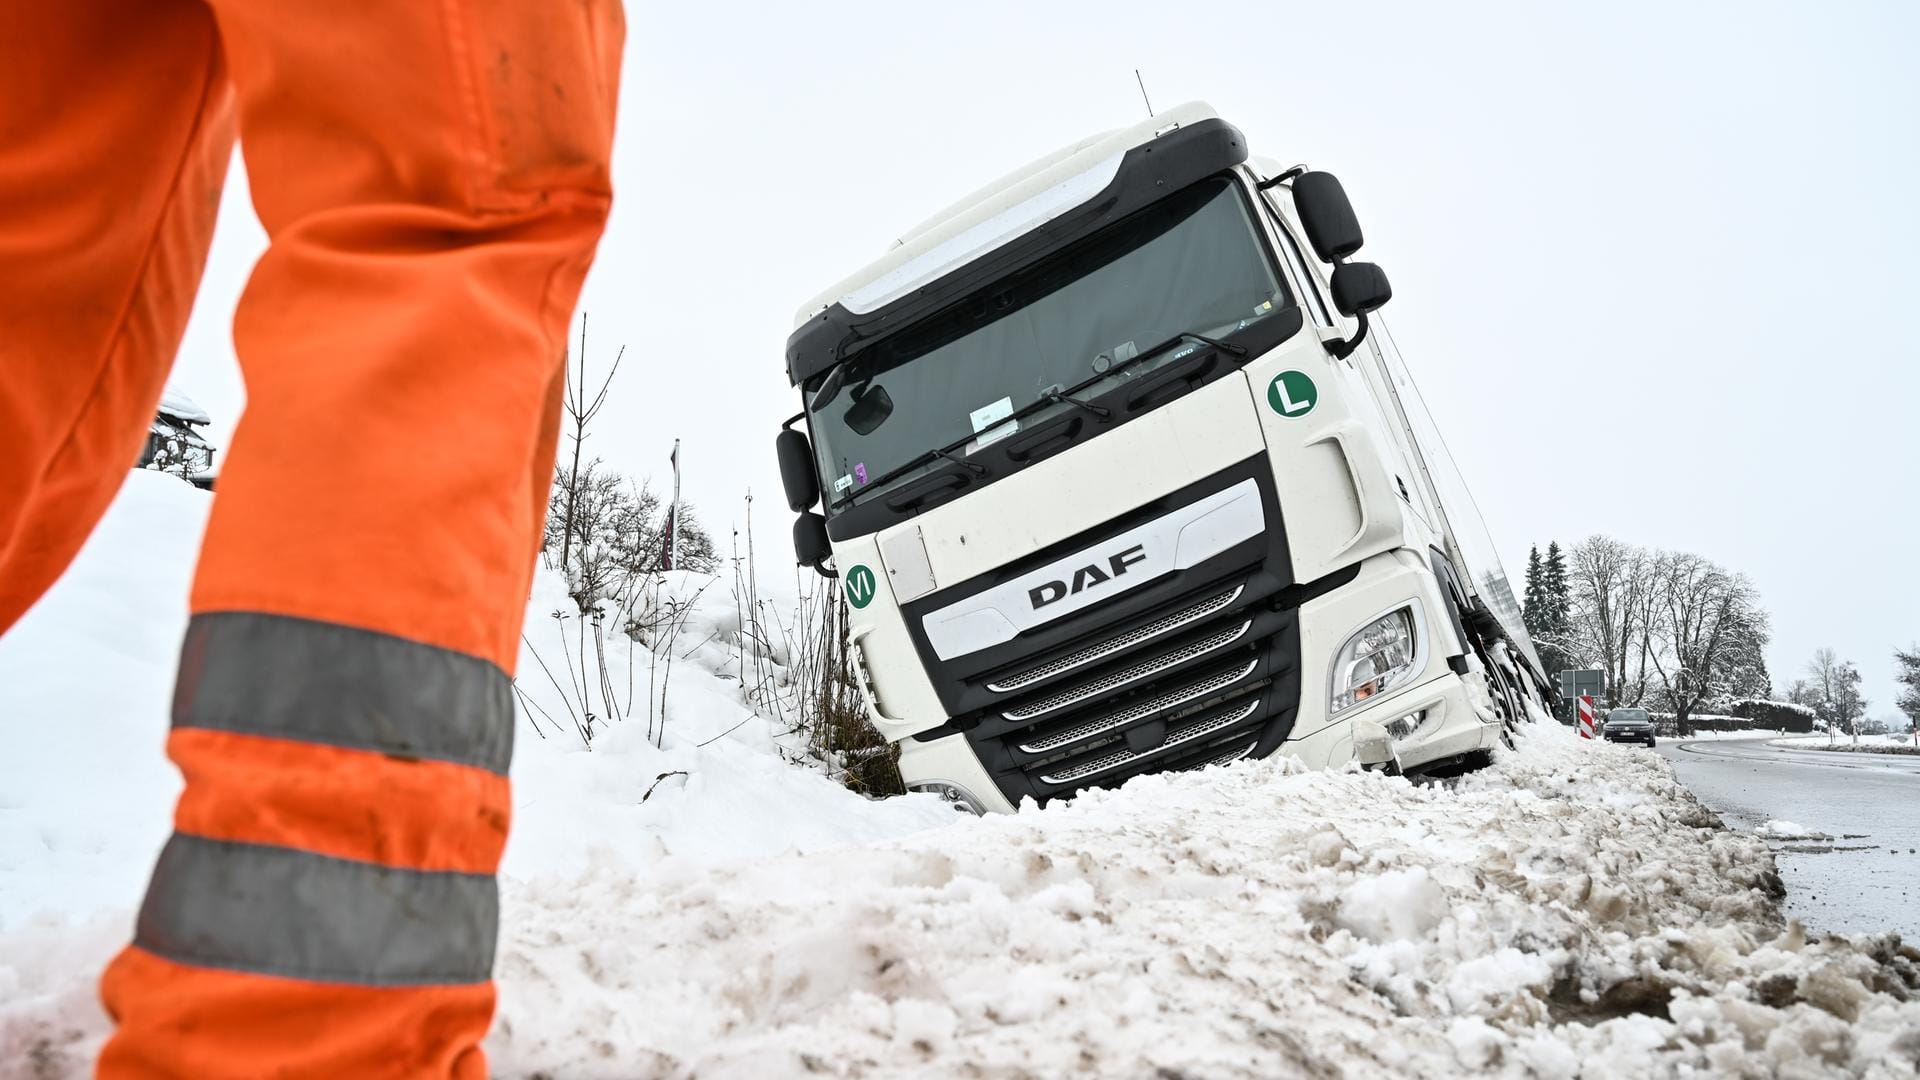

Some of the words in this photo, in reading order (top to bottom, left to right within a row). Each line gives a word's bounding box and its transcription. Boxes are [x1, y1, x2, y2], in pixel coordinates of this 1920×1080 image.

[1275, 379, 1310, 414] L
[847, 570, 871, 601] VI
[1028, 543, 1147, 610] DAF
